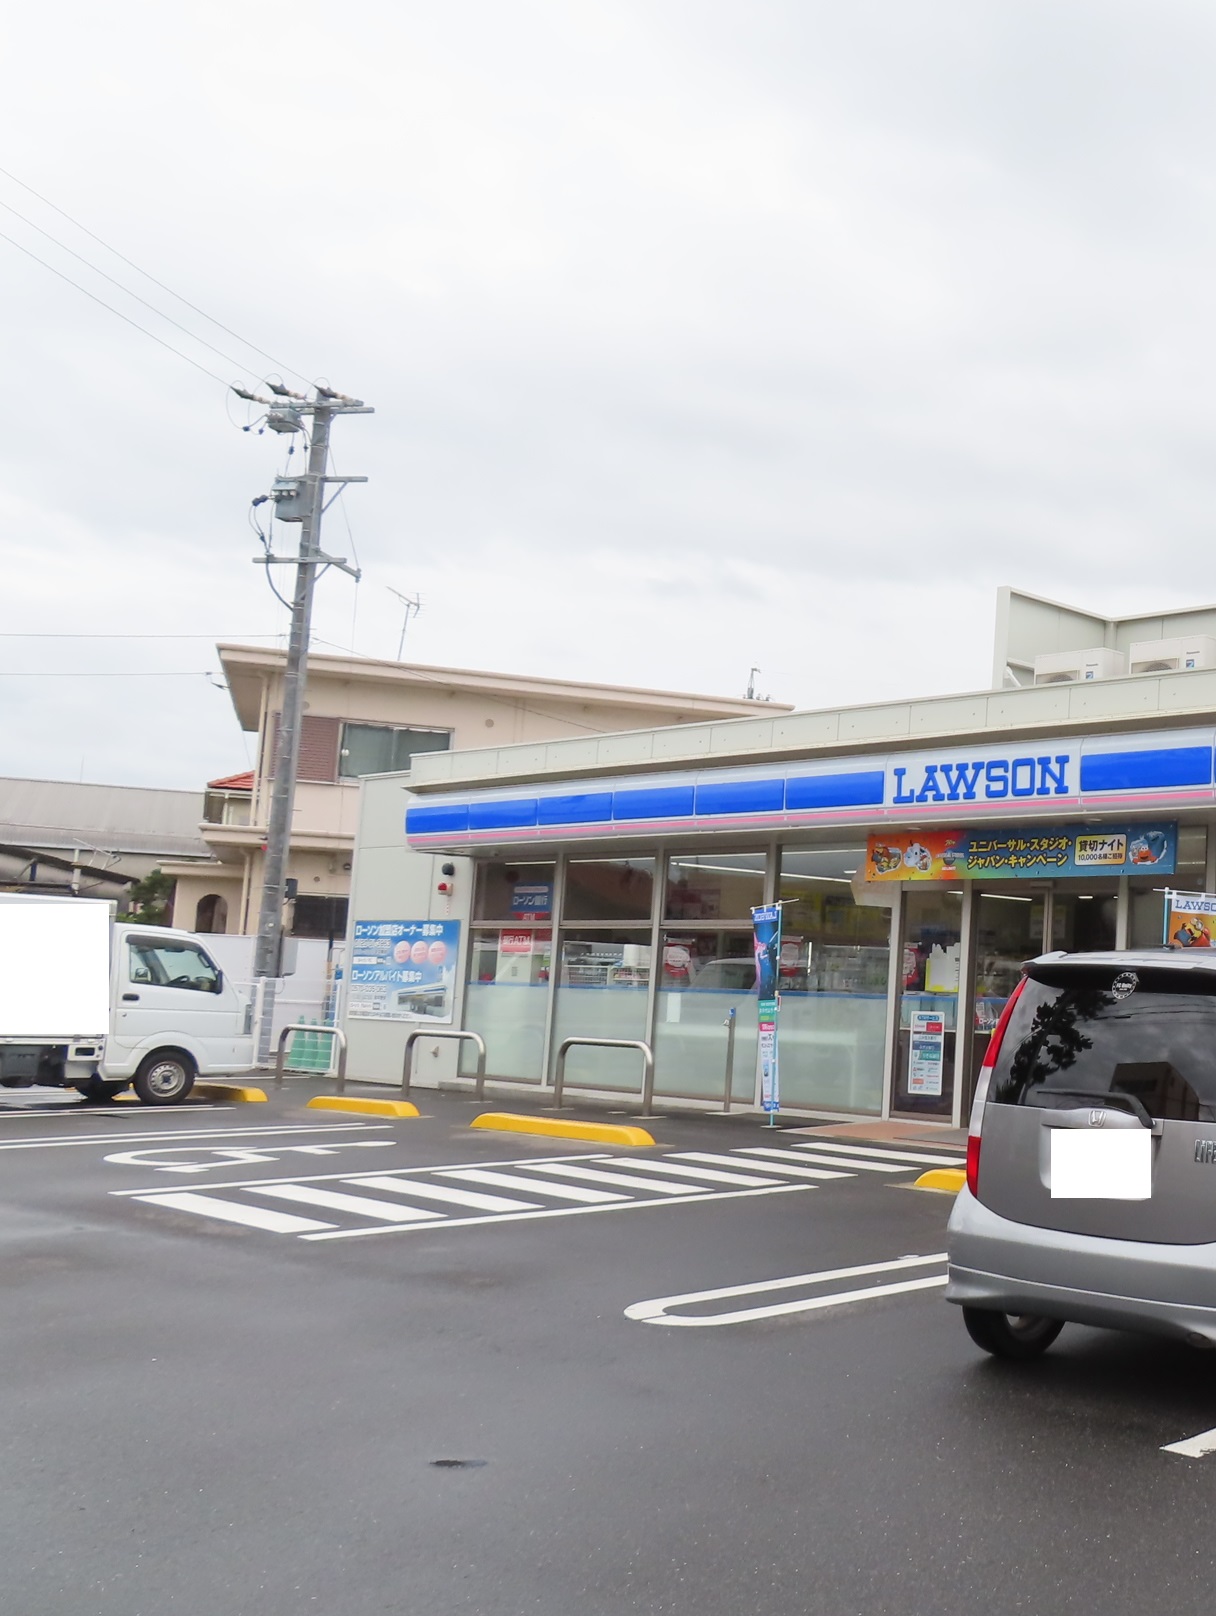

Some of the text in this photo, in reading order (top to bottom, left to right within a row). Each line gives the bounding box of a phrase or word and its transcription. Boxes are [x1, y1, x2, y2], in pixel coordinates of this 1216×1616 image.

[893, 755, 1070, 804] LAWSON
[1078, 838, 1124, 852] 貸切ナイト
[967, 852, 1069, 869] ジャパン・キャンペーン
[351, 970, 422, 983] ローソンアルバイト募集中
